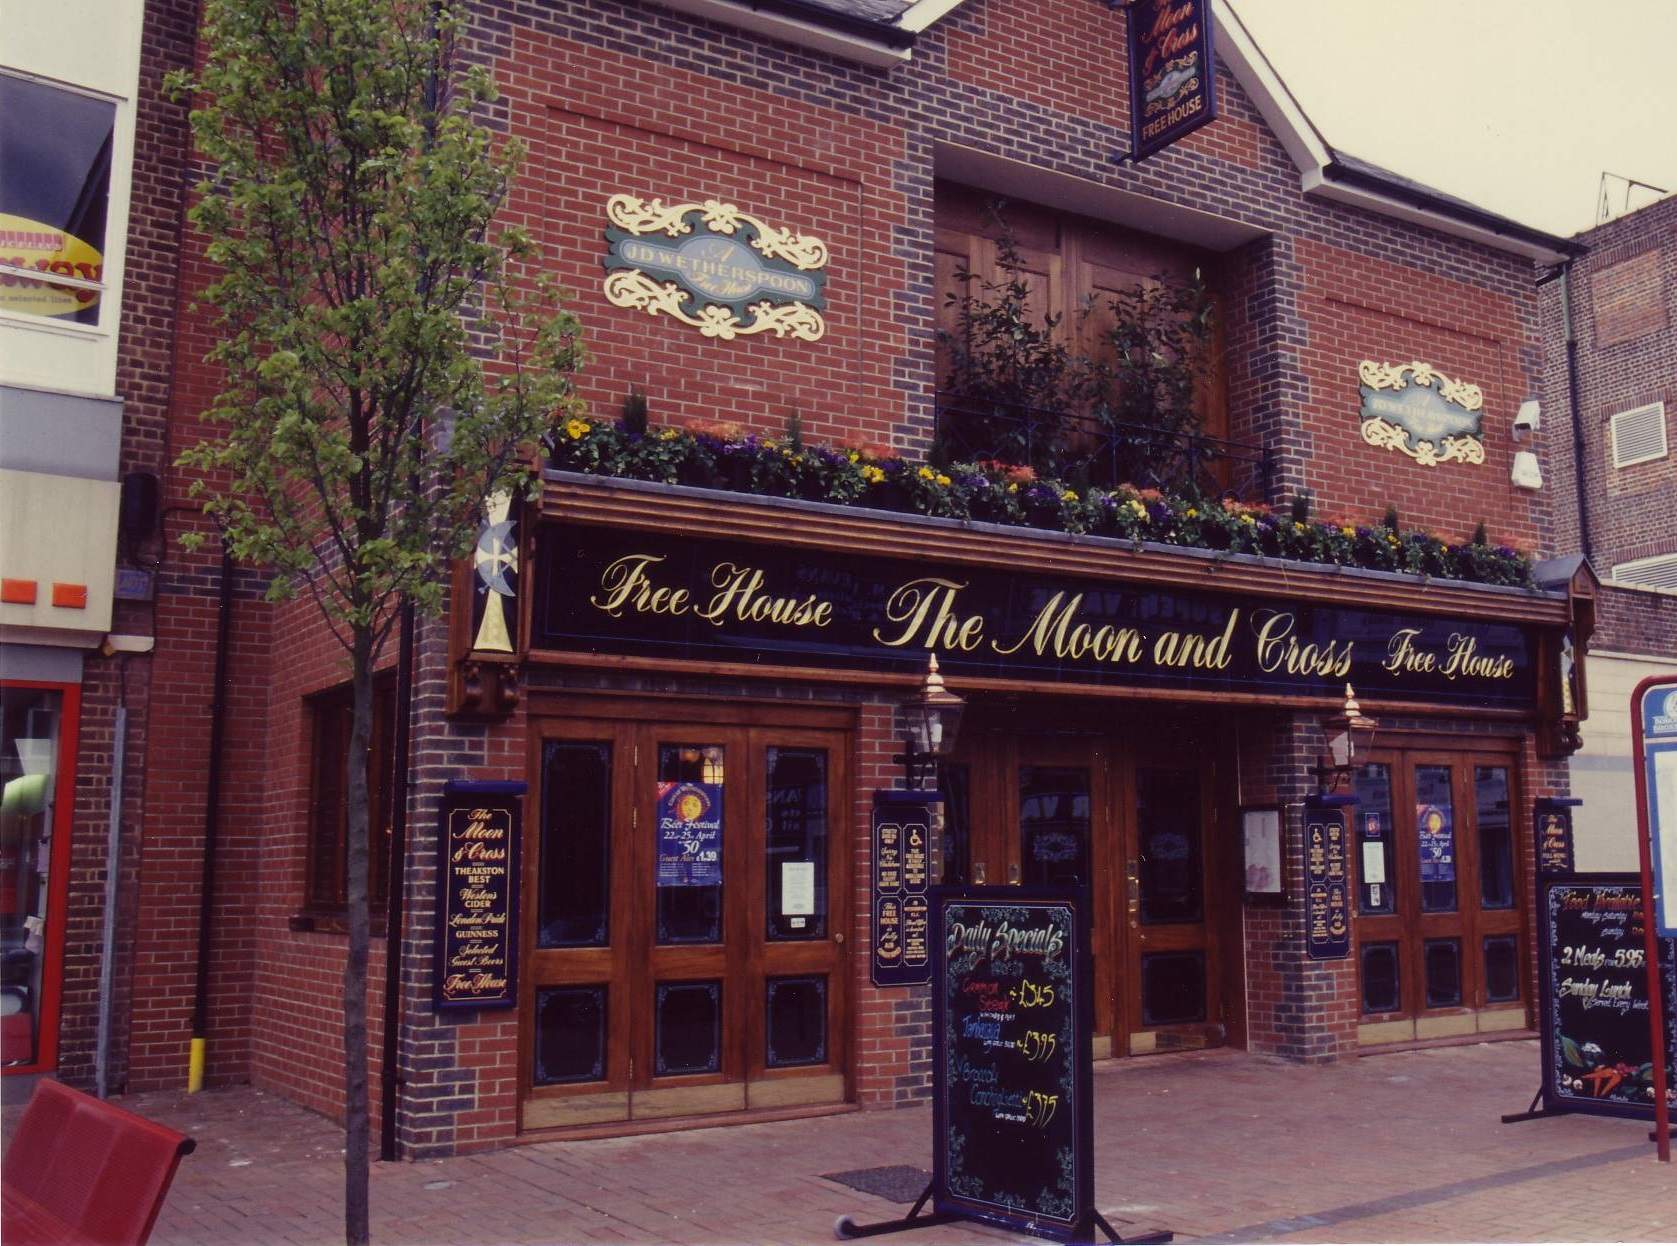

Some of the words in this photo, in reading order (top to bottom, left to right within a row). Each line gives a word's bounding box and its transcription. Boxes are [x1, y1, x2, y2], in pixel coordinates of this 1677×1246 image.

[1142, 116, 1168, 141] FREE
[1167, 95, 1202, 127] HOUSE
[658, 251, 810, 294] WETHERSPOON
[591, 553, 690, 618] Free
[694, 562, 833, 627] House
[873, 577, 984, 652] The
[992, 590, 1143, 663] Moon
[1154, 608, 1240, 670] and
[1250, 608, 1354, 678] Cross
[1381, 628, 1437, 676] Free
[1438, 632, 1515, 681] House
[467, 809, 492, 820] The
[660, 818, 683, 829] Beer
[452, 821, 503, 839] Moon
[695, 831, 716, 842] April
[464, 842, 505, 860] Cross
[455, 867, 505, 875] THEAKSTON
[468, 876, 491, 884] BEST
[464, 900, 491, 908] CIDER
[449, 913, 482, 928] London
[455, 930, 499, 938] GUINNESS
[947, 920, 993, 962] Daily
[991, 921, 1063, 962] Specials
[458, 943, 499, 957] Selected
[1561, 946, 1574, 965] 2
[1573, 945, 1606, 970] Meals
[443, 974, 473, 994] Free
[470, 973, 507, 994] House
[1559, 977, 1599, 1003] Sunday
[1599, 979, 1633, 998] Lunch
